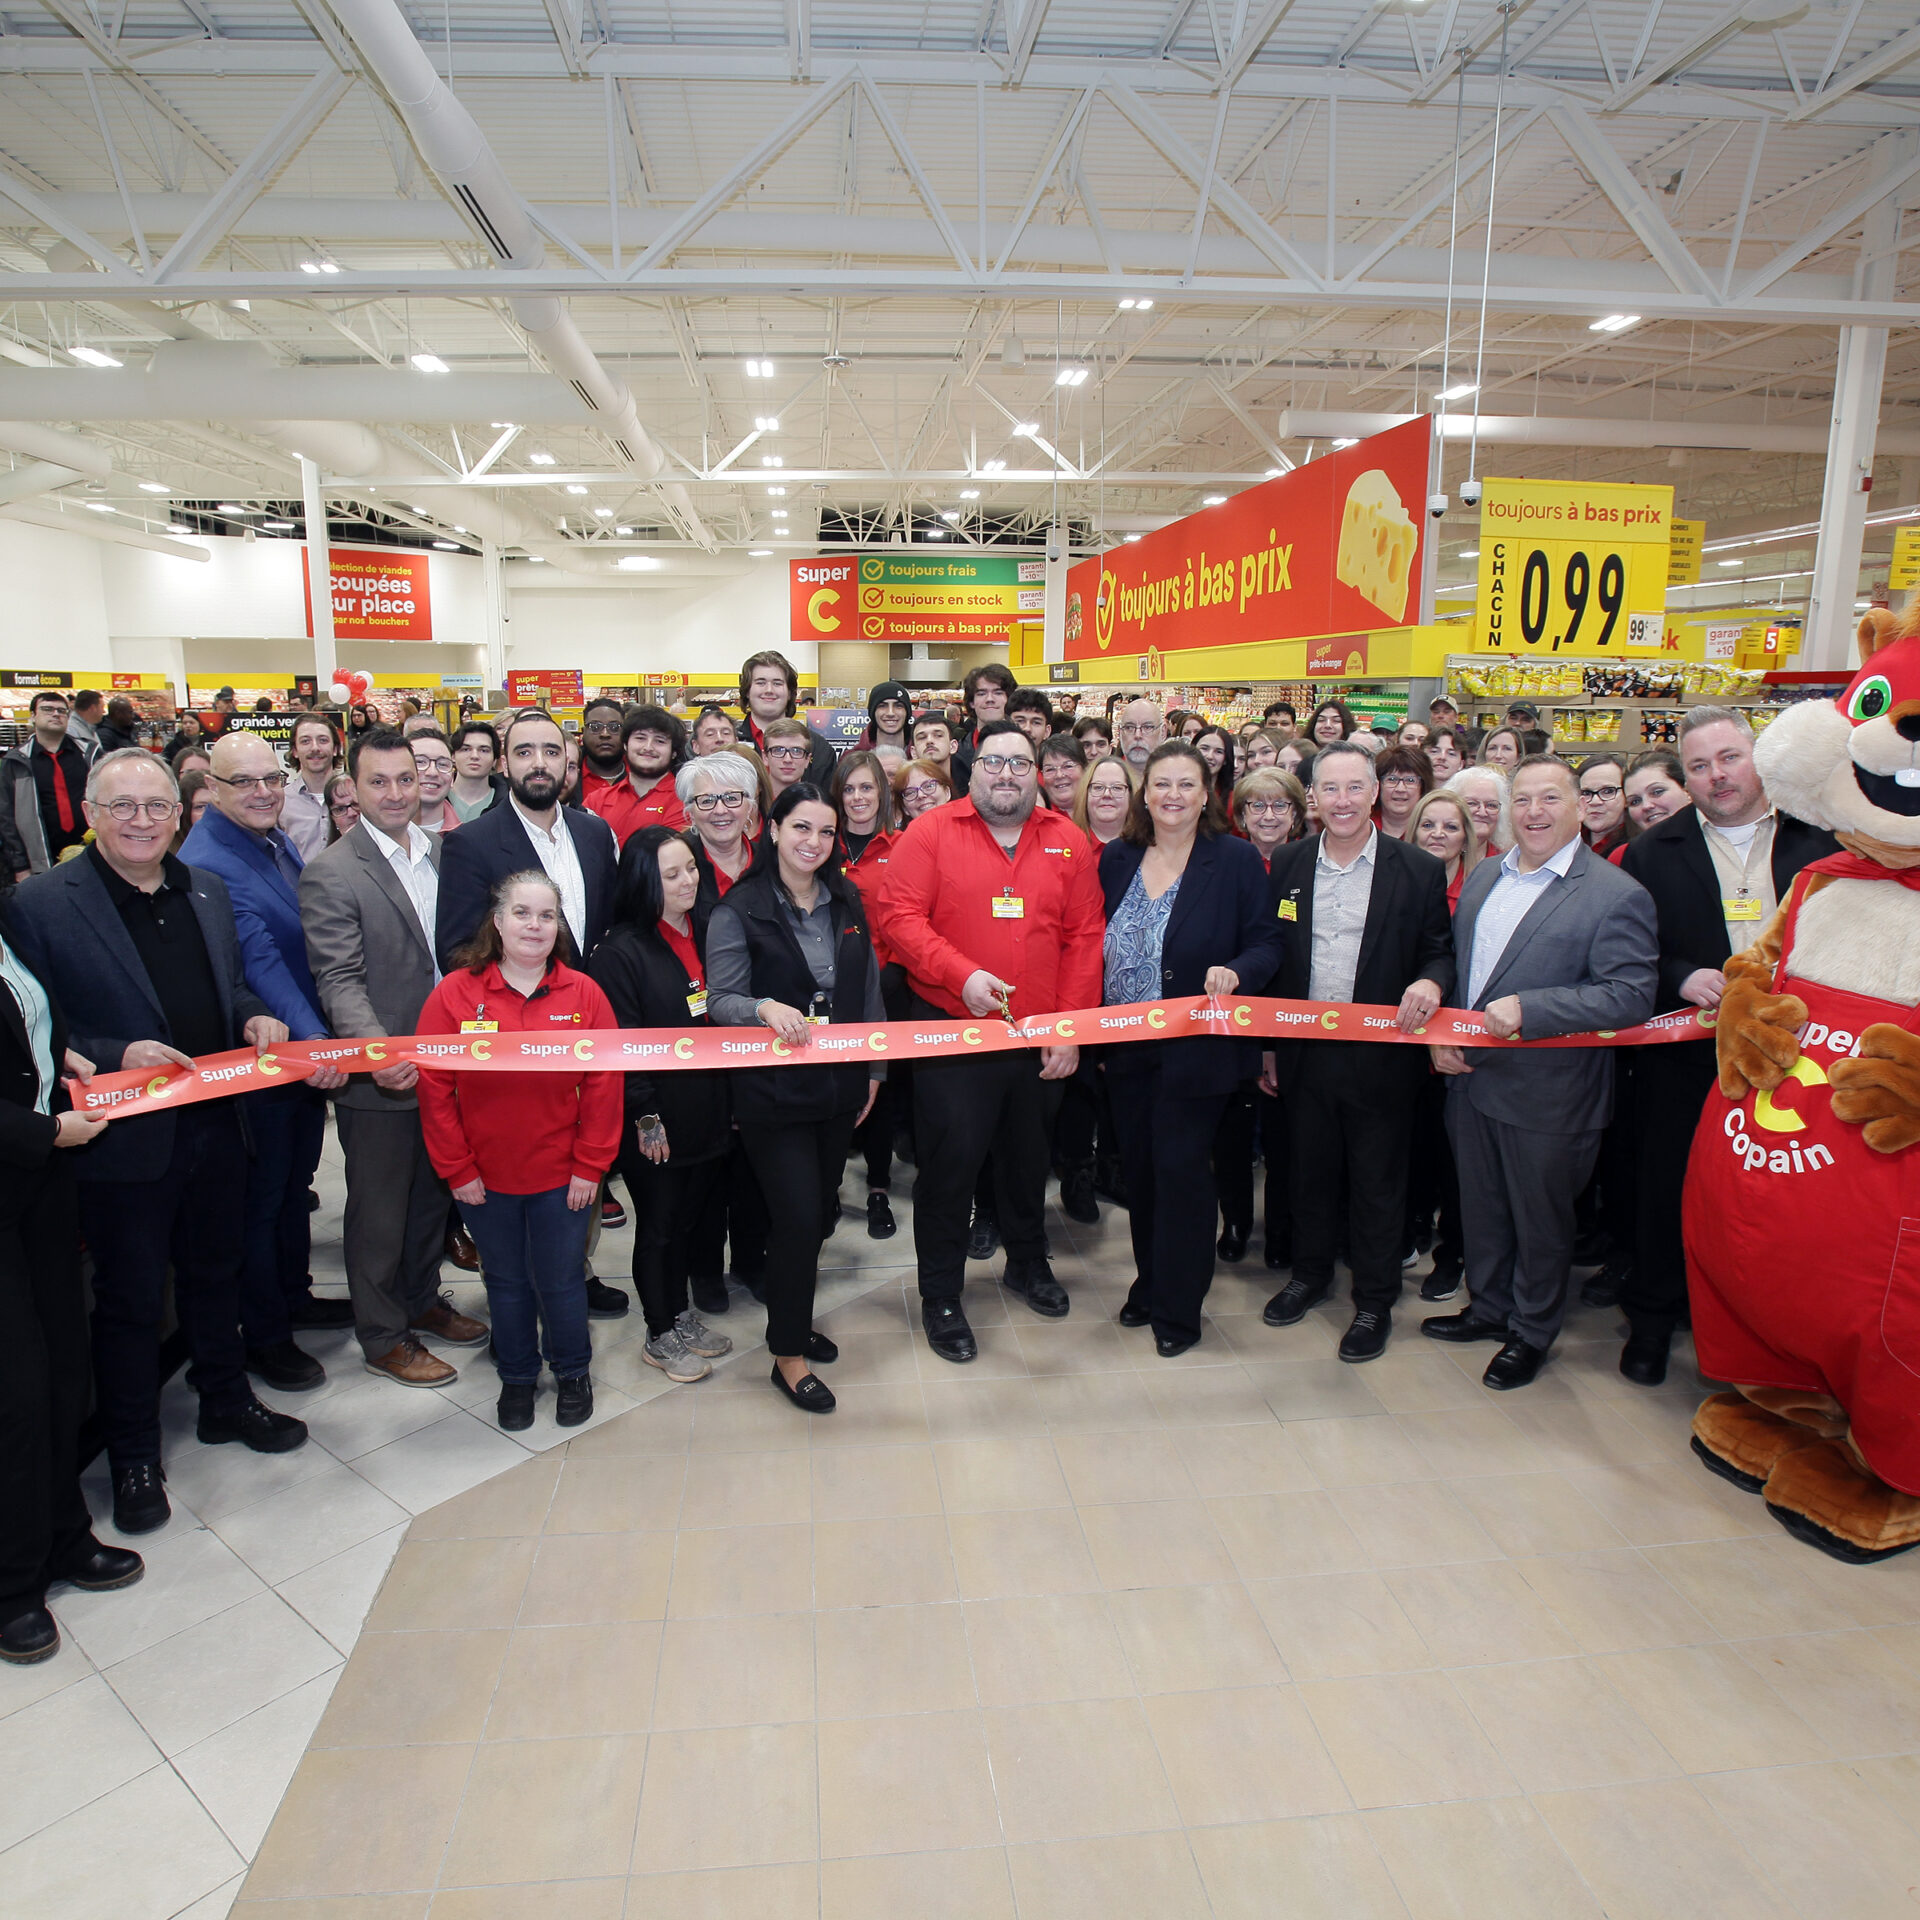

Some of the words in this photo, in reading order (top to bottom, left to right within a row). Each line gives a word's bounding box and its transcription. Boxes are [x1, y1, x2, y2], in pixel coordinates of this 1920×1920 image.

[1488, 499, 1562, 522] toujours
[1568, 502, 1578, 520] à
[1584, 502, 1618, 522] bas
[1624, 504, 1661, 526] prix
[366, 564, 376, 573] de
[378, 565, 412, 575] viandes
[797, 566, 850, 585] Super
[889, 564, 944, 578] toujours
[948, 564, 976, 576] frais
[1120, 570, 1180, 630] toujours
[1184, 558, 1194, 610] à
[1200, 552, 1234, 606] bas
[1240, 528, 1294, 614] prix
[329, 574, 412, 596] coupées
[890, 592, 944, 607] toujours
[948, 596, 963, 605] en
[967, 594, 1003, 605] stock
[1488, 544, 1505, 646] CHACUN
[1521, 550, 1624, 651] 0,99
[362, 594, 415, 616] place
[808, 588, 840, 632] C
[369, 616, 410, 626] bouchers
[889, 621, 944, 636] toujours
[948, 622, 955, 633] à
[958, 622, 981, 633] bas
[984, 622, 1010, 636] prix
[1709, 630, 1741, 641] garan
[1766, 632, 1776, 650] 5
[1316, 644, 1332, 658] super
[14, 673, 39, 684] format
[40, 674, 61, 684] écono
[516, 676, 539, 684] super
[231, 715, 276, 730] grande
[1063, 848, 1072, 858] C
[573, 1013, 581, 1022] C
[1100, 1015, 1144, 1029] Super
[1147, 1008, 1167, 1029] C
[1190, 1009, 1231, 1022] Super
[1234, 1005, 1252, 1026] C
[1275, 1011, 1318, 1024] Super
[1320, 1010, 1340, 1030] C
[1363, 1016, 1398, 1028] Supe
[1644, 1014, 1692, 1030] Super
[1697, 1009, 1717, 1028] C
[914, 1032, 959, 1045] Super
[962, 1028, 983, 1045] C
[1007, 1025, 1052, 1038] Super
[1055, 1019, 1076, 1037] C
[1452, 1021, 1488, 1035] Sup
[416, 1043, 467, 1056] Super
[471, 1040, 492, 1061] C
[520, 1044, 570, 1057] Super
[574, 1039, 594, 1061] C
[622, 1043, 671, 1056] Super
[674, 1038, 694, 1060] C
[721, 1041, 768, 1055] Super
[772, 1036, 792, 1056] C
[818, 1038, 865, 1050] Super
[868, 1032, 888, 1051] C
[309, 1047, 361, 1061] Super
[366, 1043, 388, 1060] C
[200, 1062, 253, 1083] Super
[258, 1054, 282, 1076] C
[85, 1086, 143, 1107] Super
[147, 1076, 173, 1098] C
[1754, 1055, 1829, 1132] C
[1724, 1107, 1835, 1174] Copain
